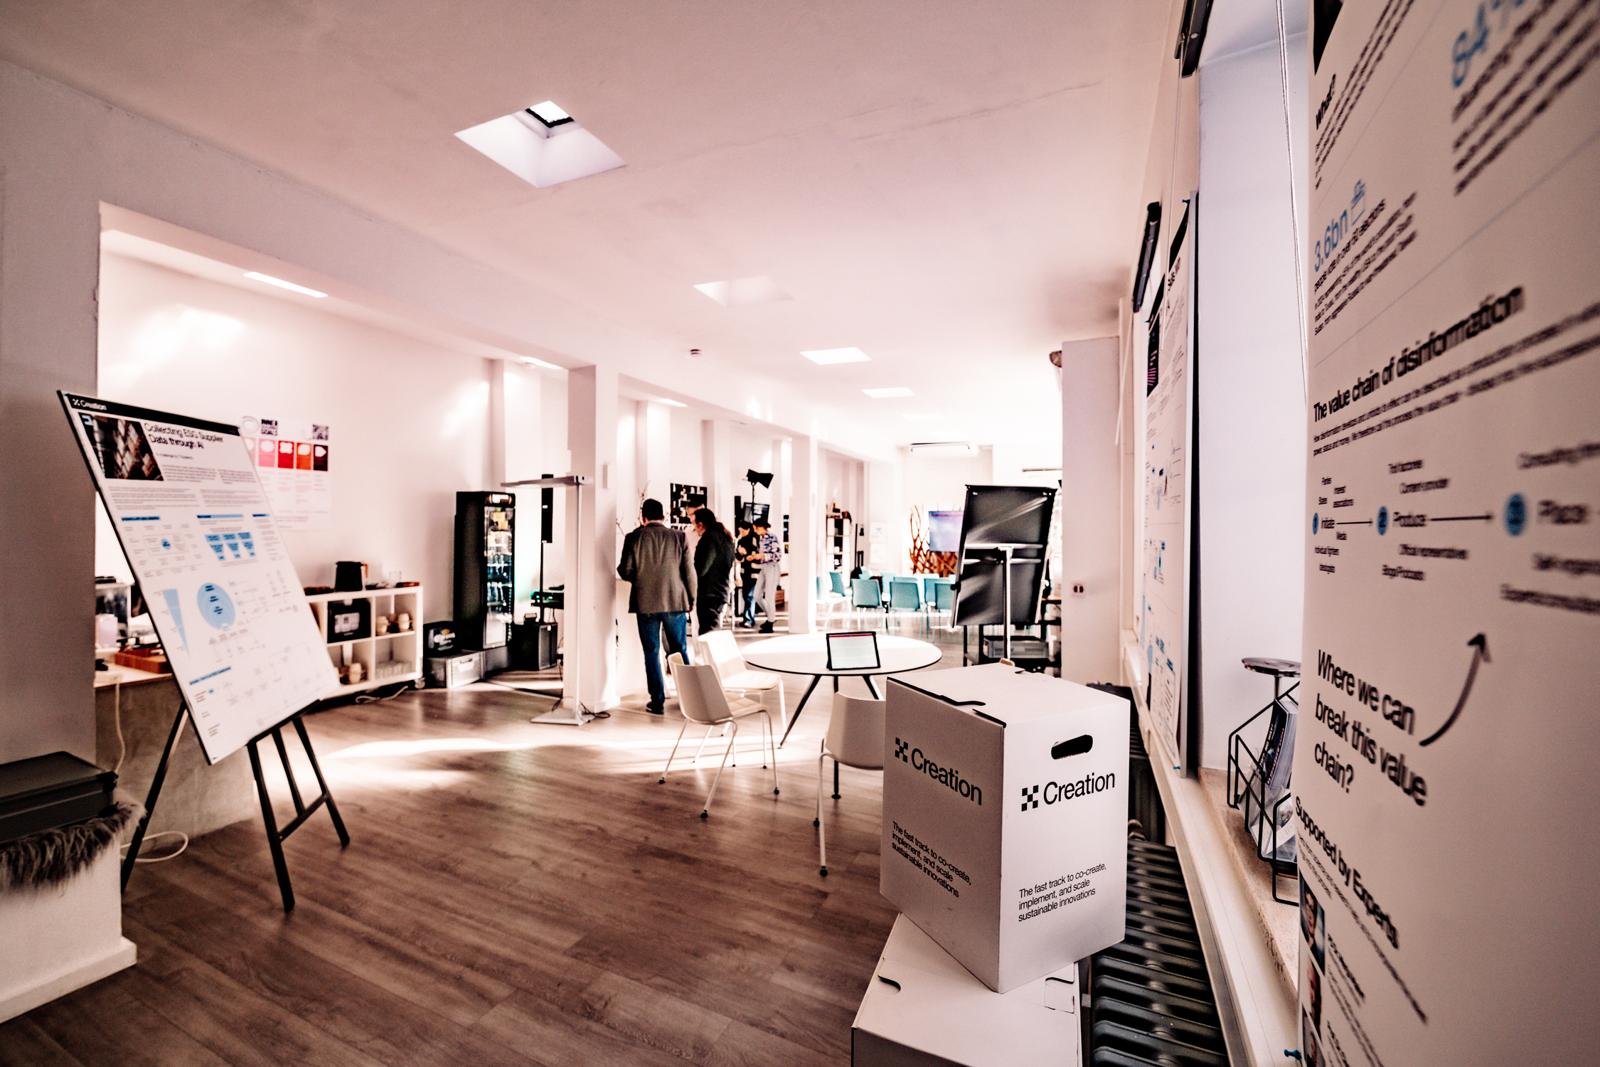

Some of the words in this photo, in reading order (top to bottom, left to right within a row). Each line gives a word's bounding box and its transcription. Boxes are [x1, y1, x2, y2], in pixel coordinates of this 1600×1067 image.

[1314, 209, 1348, 273] 3.6bn
[1314, 402, 1327, 422] The
[1328, 389, 1350, 415] value
[1352, 369, 1380, 401] chain
[1382, 356, 1395, 385] of
[1396, 286, 1525, 378] disinformation
[1317, 649, 1355, 697] Where
[1358, 679, 1379, 712] we
[1382, 694, 1416, 736] can
[910, 747, 983, 806] Creation
[1314, 741, 1355, 794] chain?
[1315, 692, 1350, 742] break
[1352, 719, 1377, 765] this
[1380, 747, 1427, 807] value
[1043, 772, 1116, 806] Creation
[892, 820, 904, 835] The
[904, 829, 915, 844] fast
[915, 838, 930, 855] track
[930, 848, 938, 860] to
[938, 855, 972, 886] co-create,
[892, 830, 923, 861] implement,
[923, 855, 936, 869] and
[936, 864, 954, 882] scale
[892, 842, 923, 871] sustainable
[923, 863, 960, 899] innovations
[1295, 796, 1337, 866] Supported
[1338, 849, 1351, 887] by
[1018, 889, 1058, 911] implement,
[1059, 884, 1072, 897] and
[1073, 878, 1091, 892] scale
[1018, 900, 1058, 923] sustainable
[1059, 887, 1096, 908] innovations
[1019, 887, 1034, 899] The
[1034, 881, 1048, 894] fast
[1049, 875, 1066, 889] track
[1067, 873, 1074, 883] to
[1075, 863, 1107, 880] co-create,
